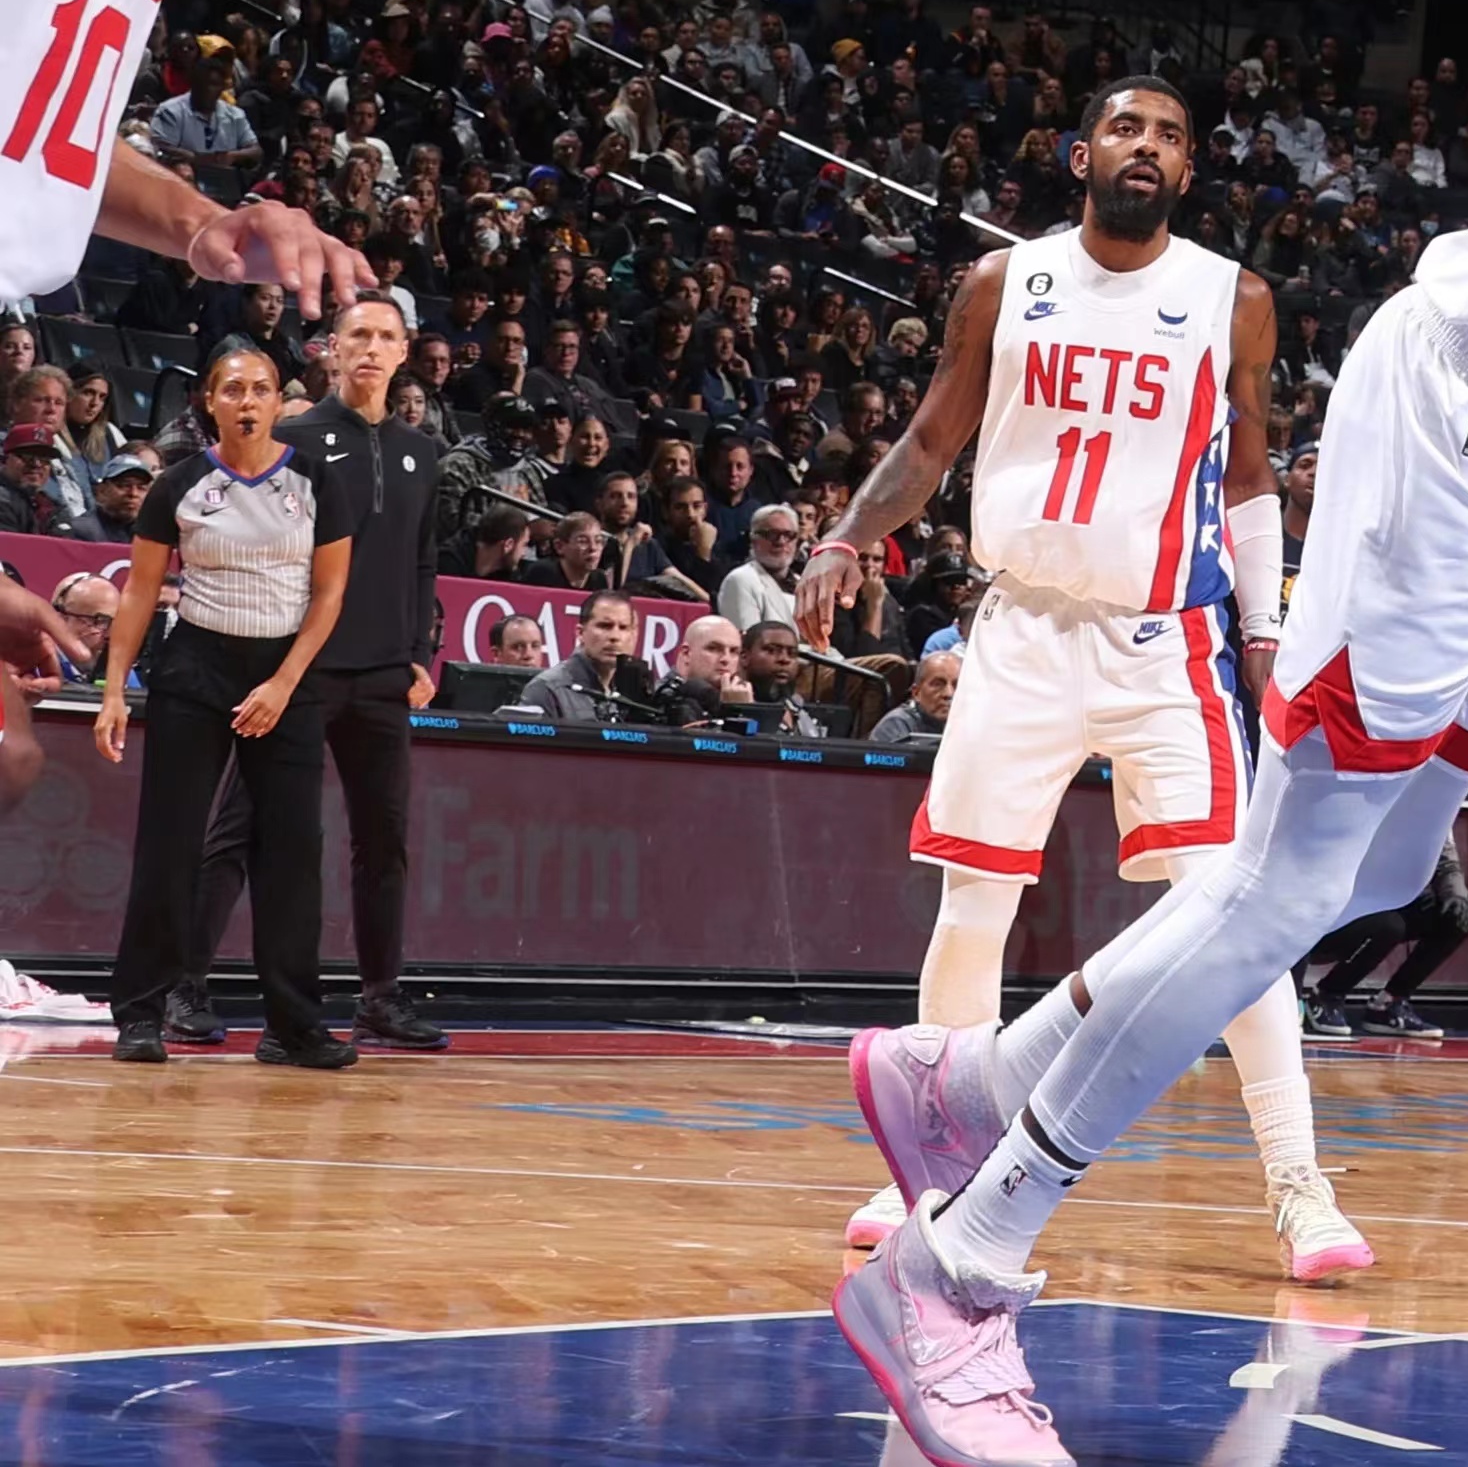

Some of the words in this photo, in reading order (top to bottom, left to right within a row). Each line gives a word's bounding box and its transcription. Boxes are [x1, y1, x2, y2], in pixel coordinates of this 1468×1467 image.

[1024, 340, 1170, 421] NETS
[1041, 426, 1112, 525] 11
[417, 716, 459, 729] BARCLAYS
[515, 723, 556, 737] BARCLAYS
[609, 730, 649, 744] BARCLAYS
[700, 739, 737, 753] BARCLAYS
[787, 749, 823, 763] BARCLAYS
[872, 754, 906, 767] BARCLAYS
[420, 784, 641, 921] Farm
